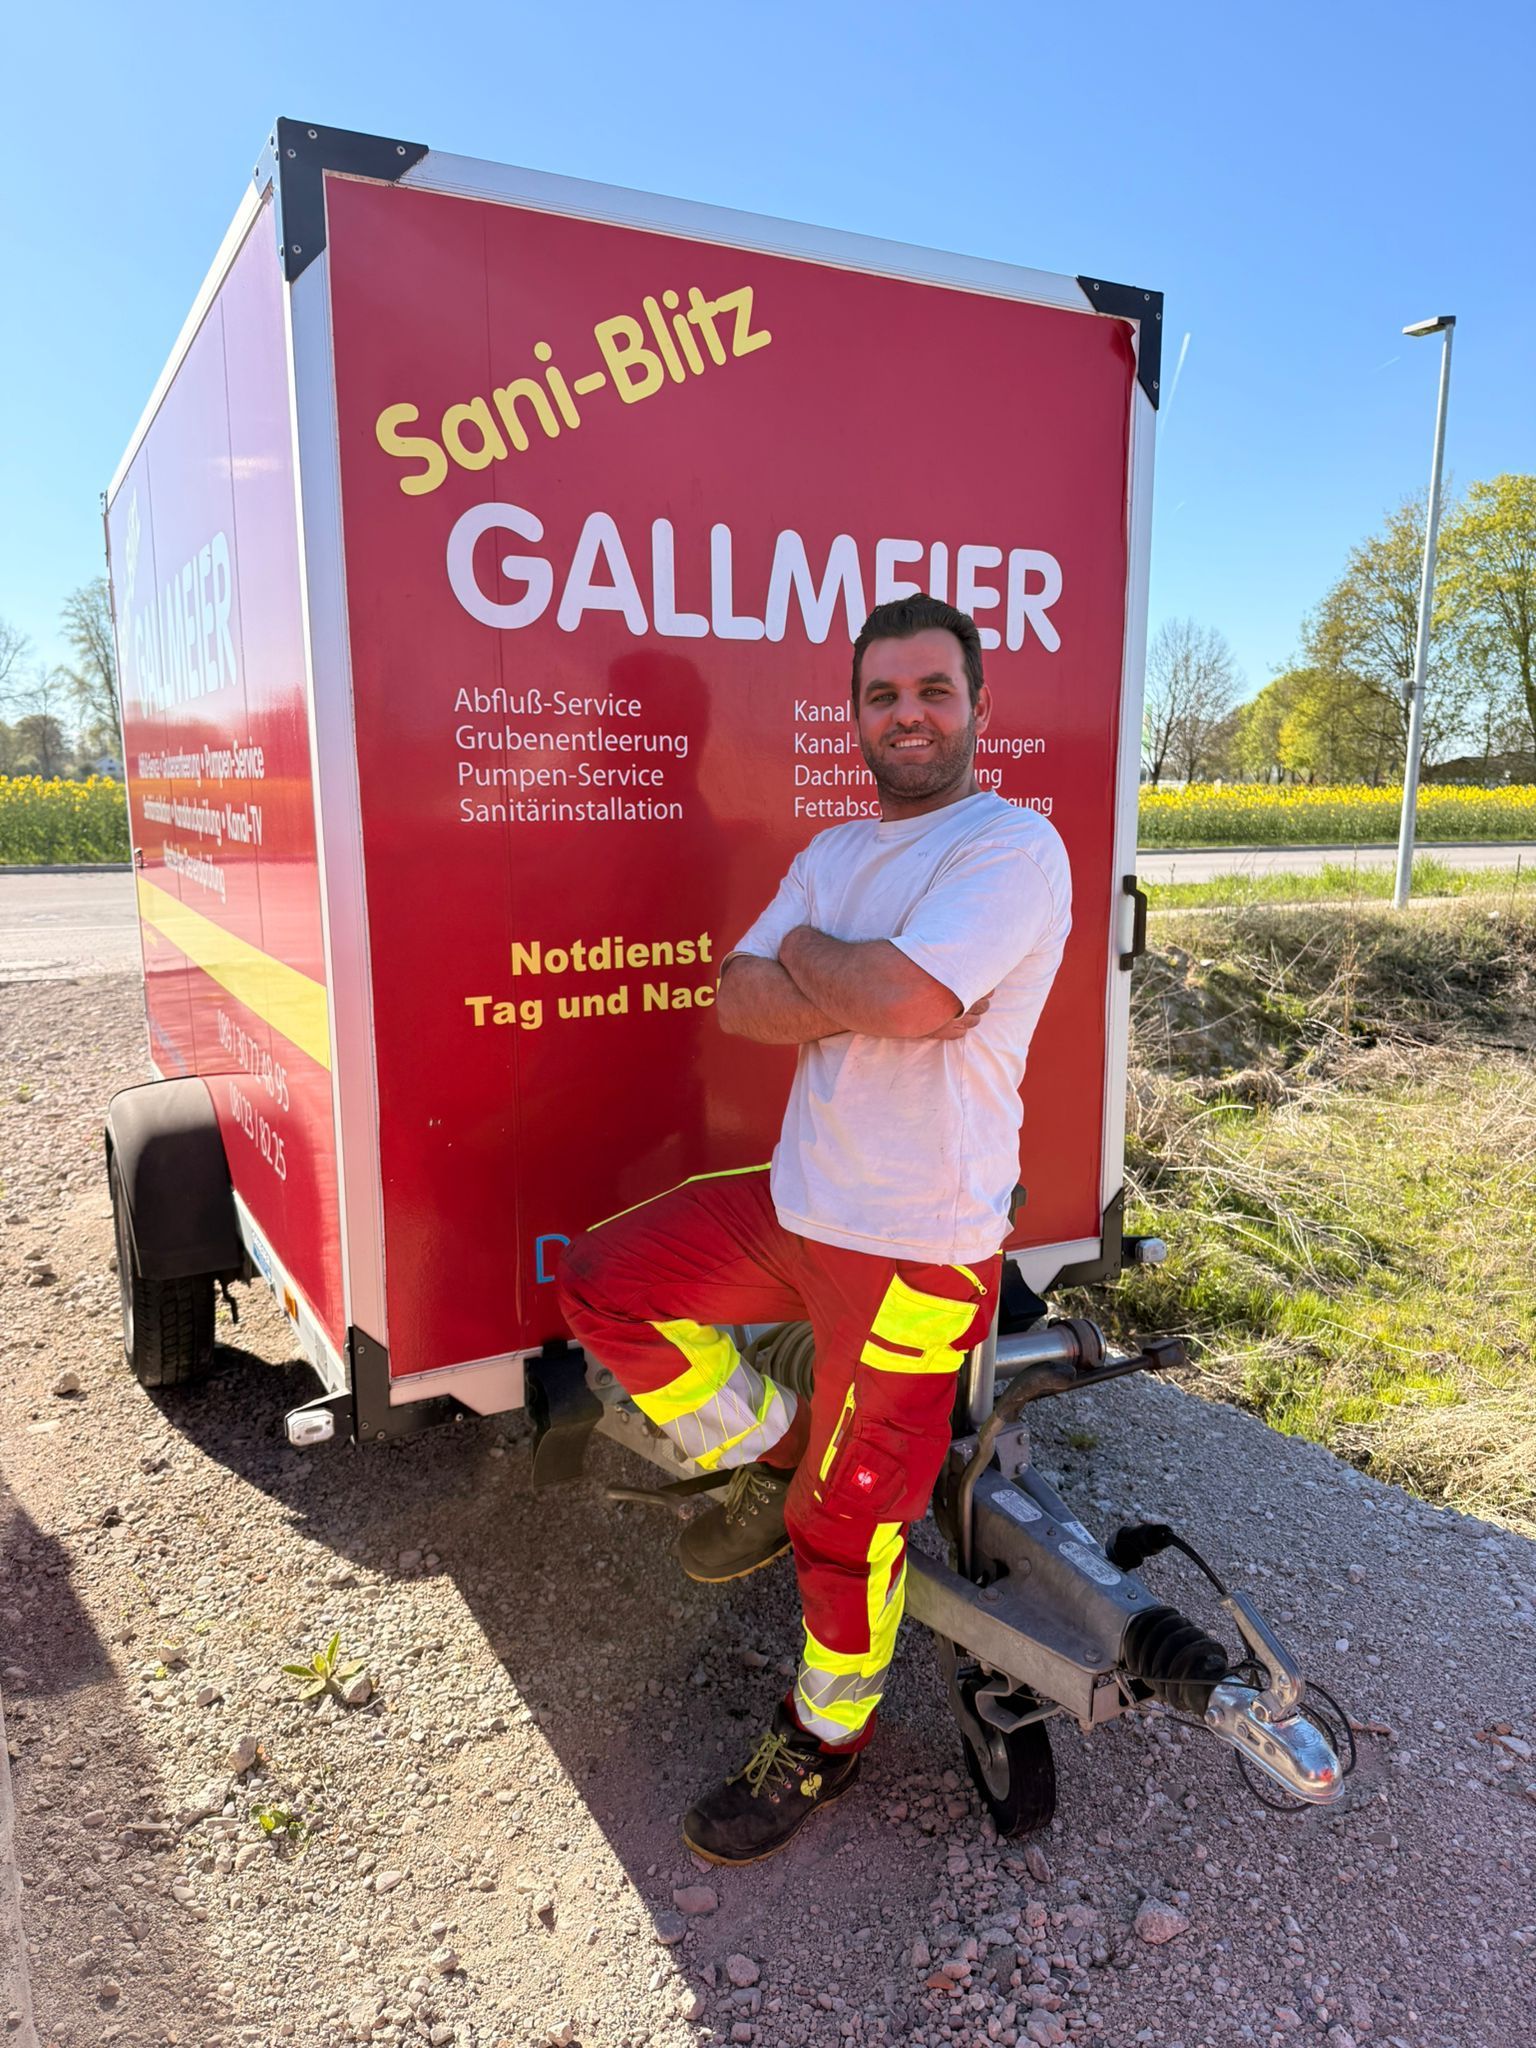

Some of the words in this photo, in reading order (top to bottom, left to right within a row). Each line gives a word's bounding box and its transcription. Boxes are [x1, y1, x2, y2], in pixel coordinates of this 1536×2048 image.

[375, 285, 772, 496] Sani-Blitz
[447, 502, 1063, 653] GALLMEIER
[133, 531, 237, 720] GALLMEIER
[454, 687, 642, 717] Abfluß-Service
[794, 700, 850, 722] Kanal
[455, 725, 688, 758] Grubenentleerung
[794, 733, 859, 754] Kanal-
[458, 762, 664, 792] Pumpen-Service
[794, 765, 877, 786] Dachrin
[460, 797, 683, 822] Sanitärinstallation
[794, 797, 882, 818] Fettabsc
[226, 802, 262, 845] Kanal-TV
[511, 931, 712, 976] Notdienst
[465, 996, 543, 1030] Tag
[558, 985, 628, 1019] und
[643, 978, 721, 1012] Nac
